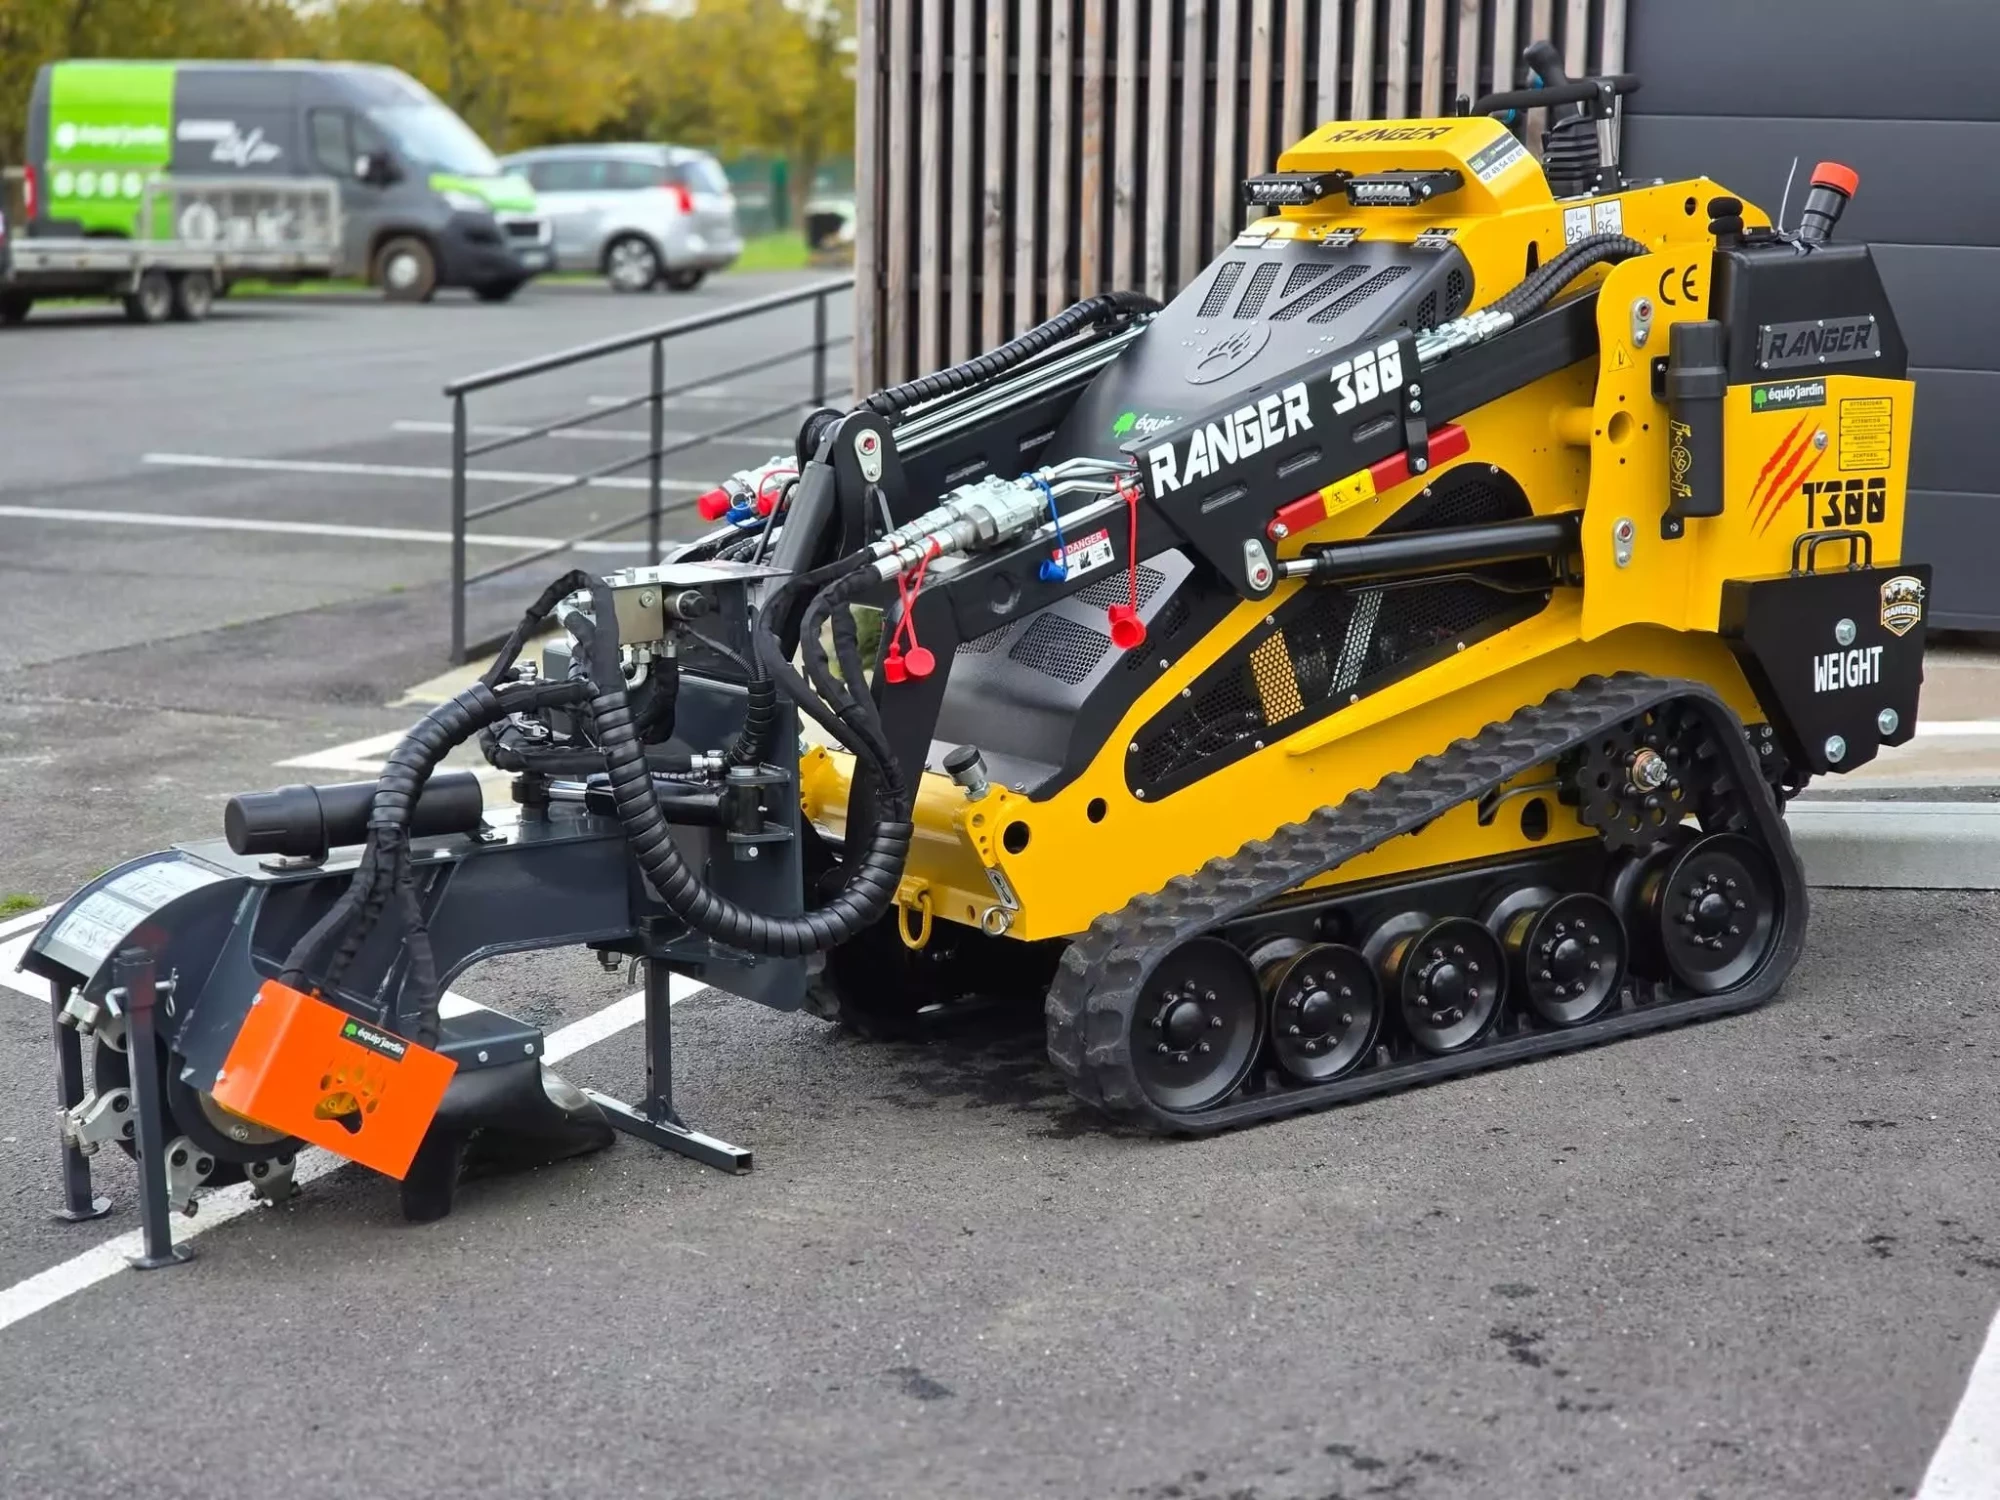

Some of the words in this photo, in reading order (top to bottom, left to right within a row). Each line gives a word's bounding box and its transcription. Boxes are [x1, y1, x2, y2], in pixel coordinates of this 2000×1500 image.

[1325, 127, 1454, 142] RANGER
[1767, 324, 1873, 359] RANGER
[1148, 381, 1314, 499] RANGER
[1330, 339, 1404, 415] 300
[1801, 477, 1886, 529] T300
[1067, 532, 1103, 554] DANGER
[1884, 604, 1918, 618] RANGER
[1814, 646, 1884, 693] WEIGHT
